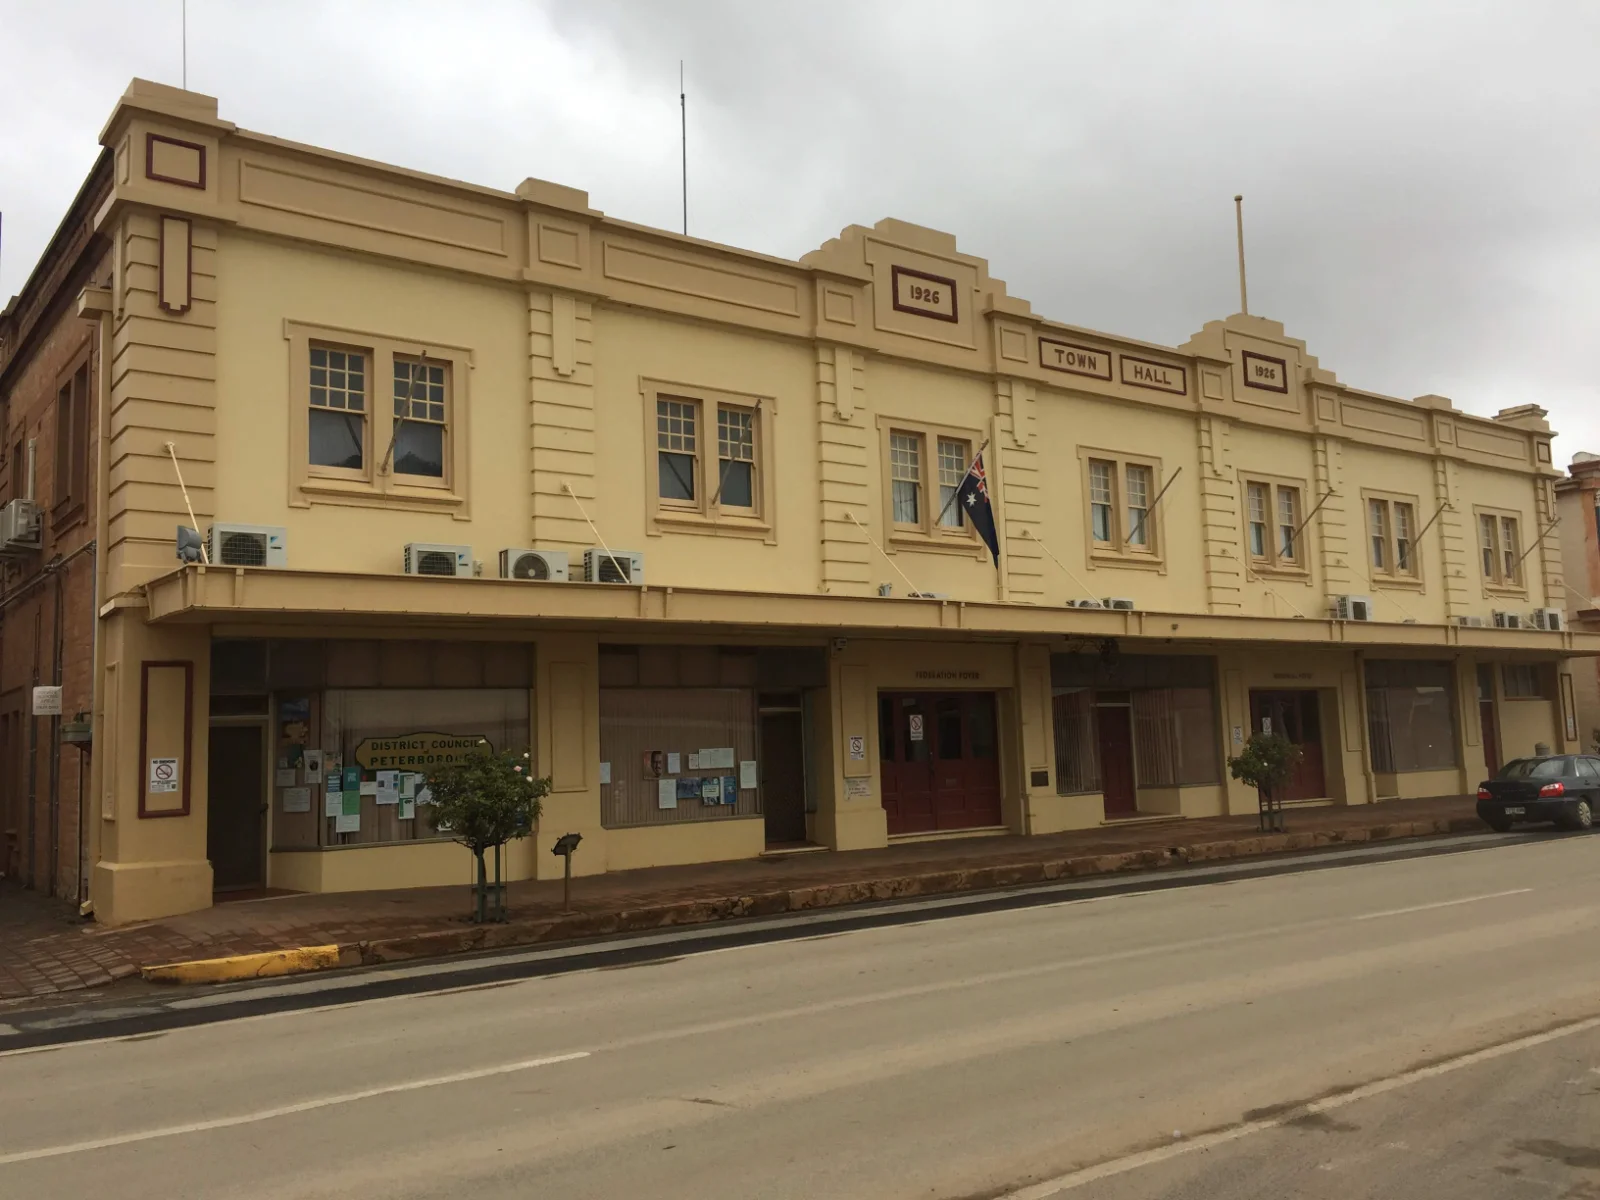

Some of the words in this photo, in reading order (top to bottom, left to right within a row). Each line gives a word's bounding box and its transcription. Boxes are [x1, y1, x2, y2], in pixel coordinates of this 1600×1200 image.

[910, 284, 940, 304] 1926
[1054, 348, 1097, 371] TOWN
[1134, 365, 1172, 386] HALL
[1255, 365, 1276, 380] 1926
[915, 670, 957, 680] FEDERATION
[959, 671, 980, 680] FOYER
[371, 740, 426, 751] DISTRICT
[431, 739, 480, 749] COUNCIL
[370, 753, 476, 767] PETERBOROG
